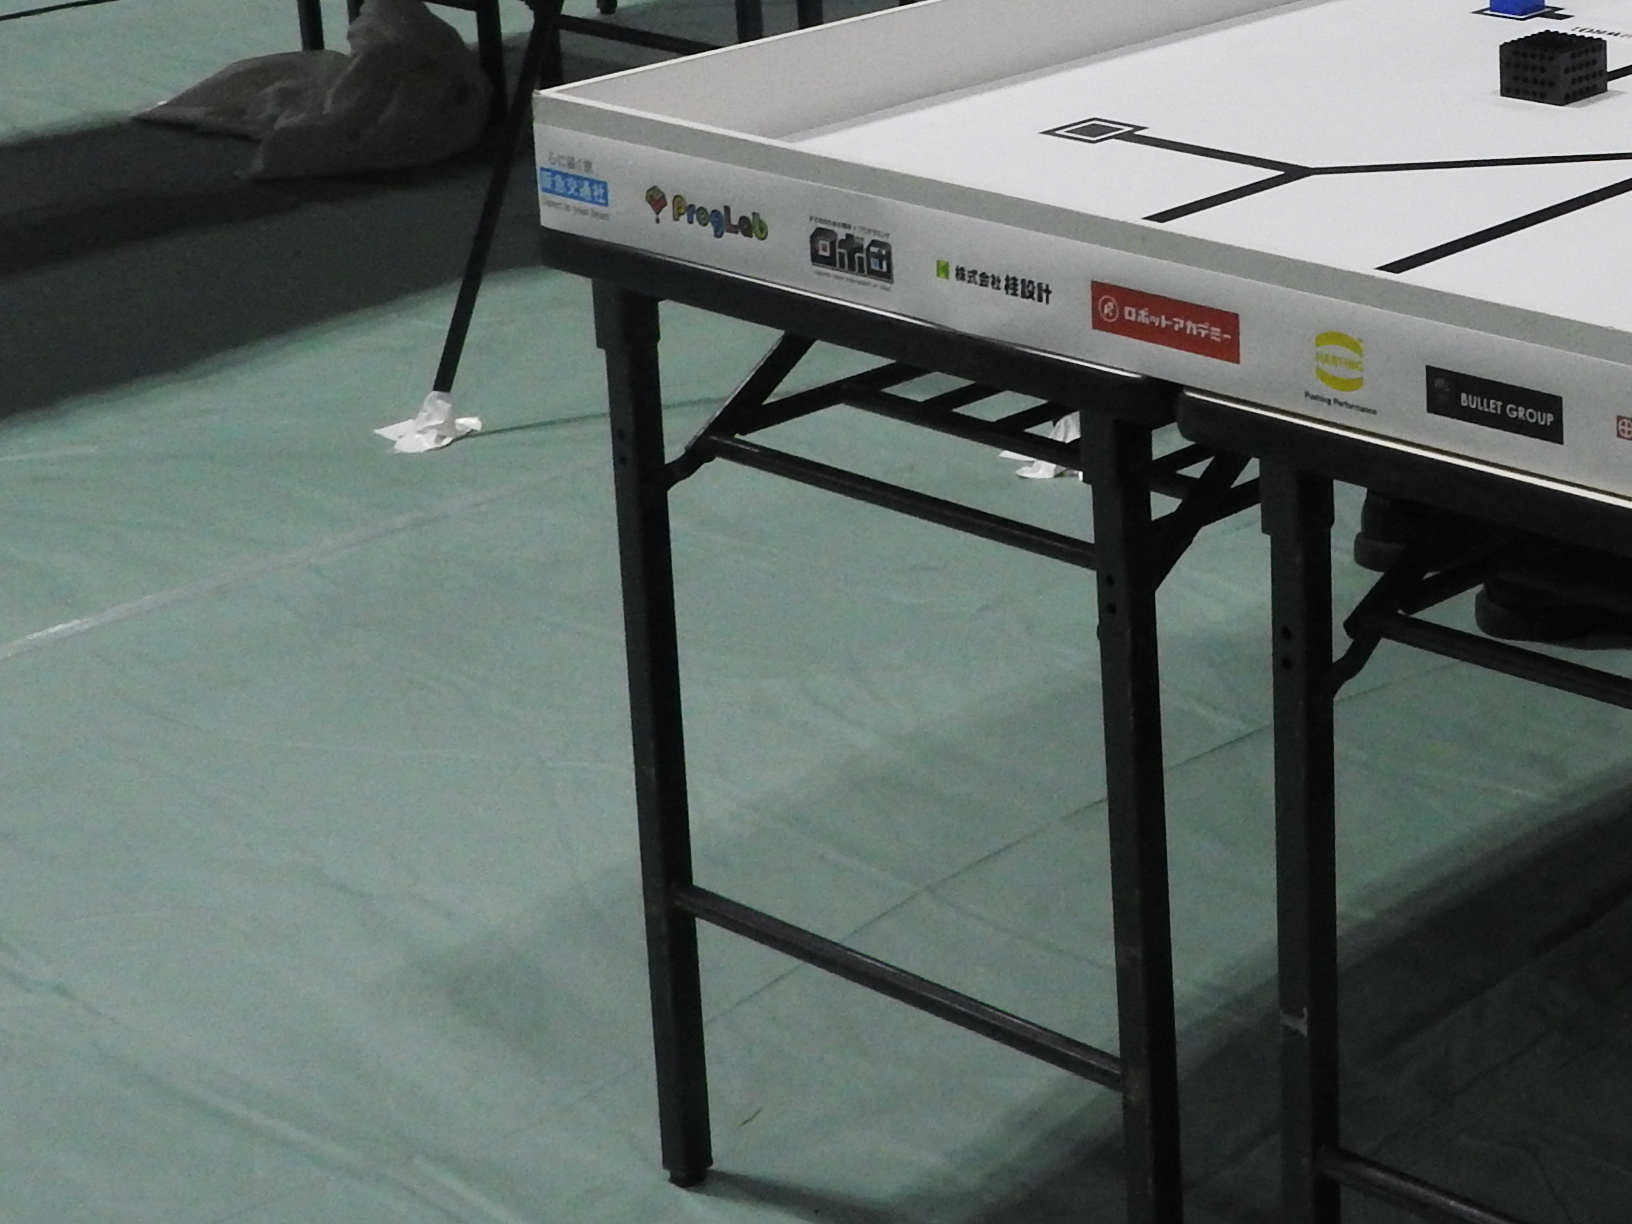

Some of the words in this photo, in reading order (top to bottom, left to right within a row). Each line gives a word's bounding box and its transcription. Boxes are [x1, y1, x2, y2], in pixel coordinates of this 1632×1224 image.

[671, 194, 769, 241] ProgLab
[1123, 305, 1232, 343] ロボットアカデミー
[1460, 391, 1503, 415] BULLET
[1505, 403, 1555, 427] GROUP
